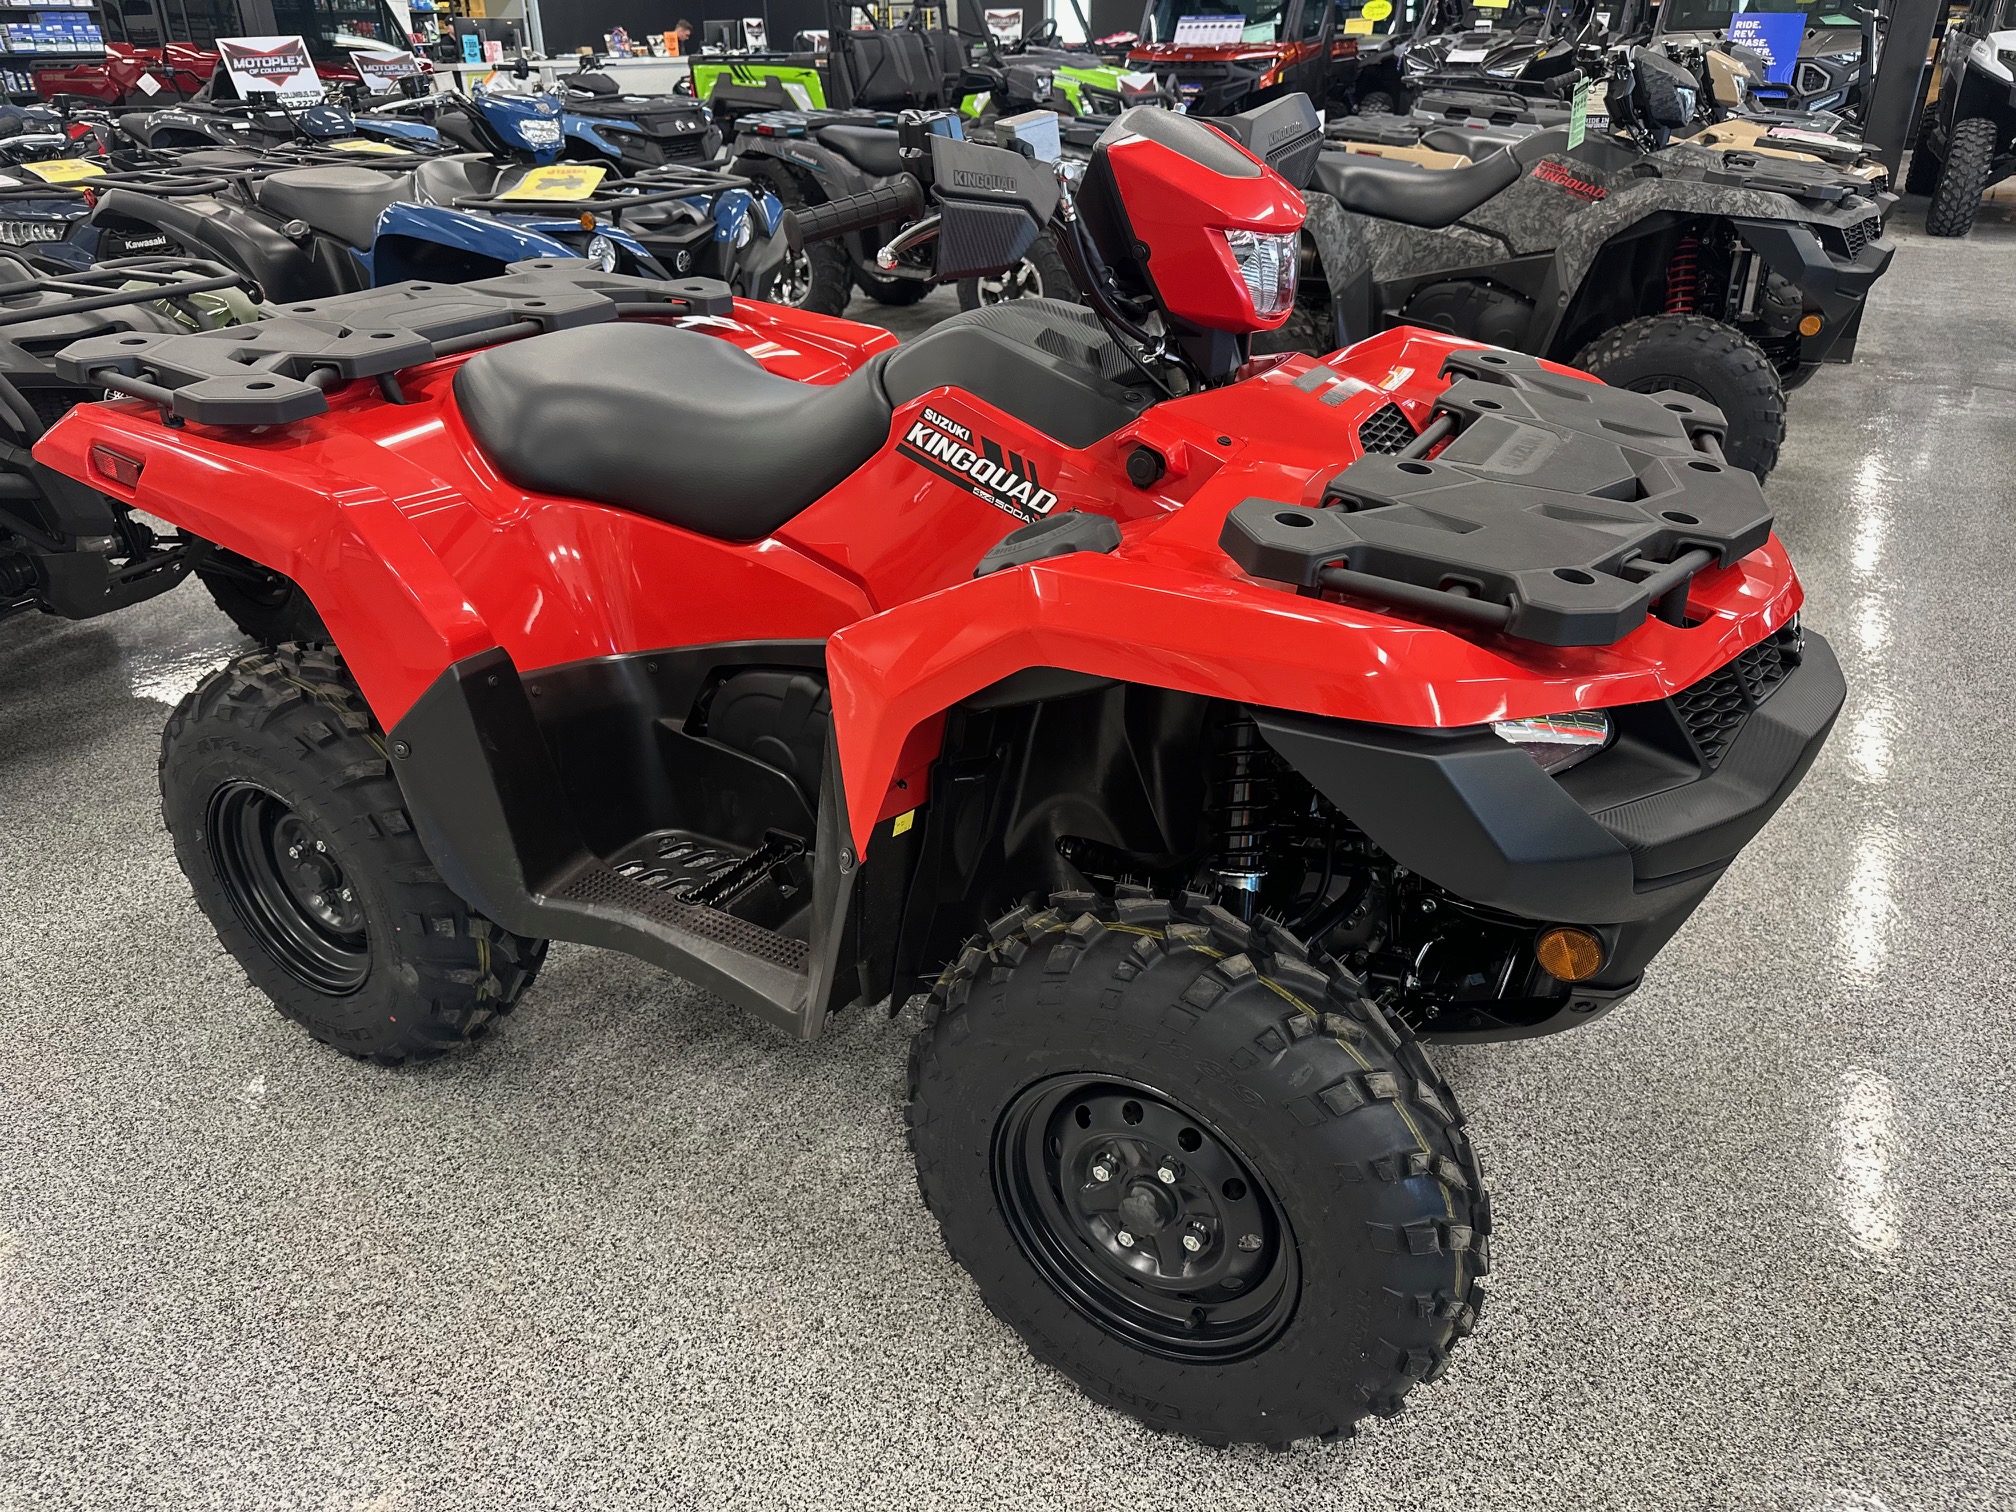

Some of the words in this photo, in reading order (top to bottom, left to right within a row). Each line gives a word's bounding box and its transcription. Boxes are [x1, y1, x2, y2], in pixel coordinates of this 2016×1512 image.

[233, 55, 304, 69] MOTOPLEX
[363, 64, 416, 72] MOTOPLEX
[954, 170, 1017, 192] KINGQUAD
[1532, 167, 1608, 198] KINGQUAD
[125, 236, 166, 250] Kawasaki
[924, 408, 970, 441] SUZUKI
[906, 422, 1058, 514] KINGQUAD
[973, 487, 994, 504] 4x4
